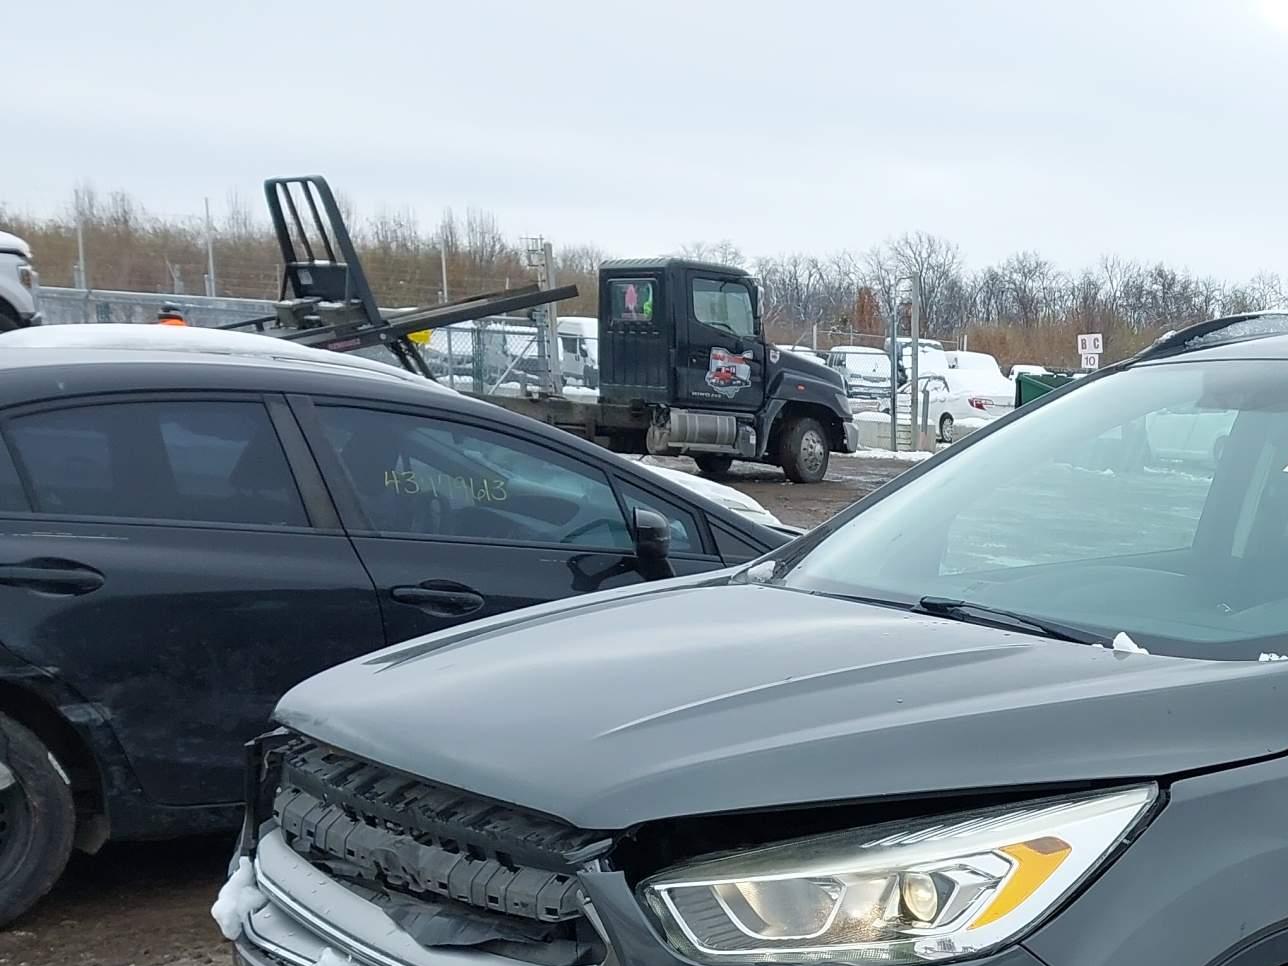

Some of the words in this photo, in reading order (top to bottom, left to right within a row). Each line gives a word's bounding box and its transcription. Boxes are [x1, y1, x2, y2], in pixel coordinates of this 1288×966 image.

[1081, 338, 1087, 350] B
[1093, 337, 1100, 350] C
[1084, 356, 1096, 366] 10
